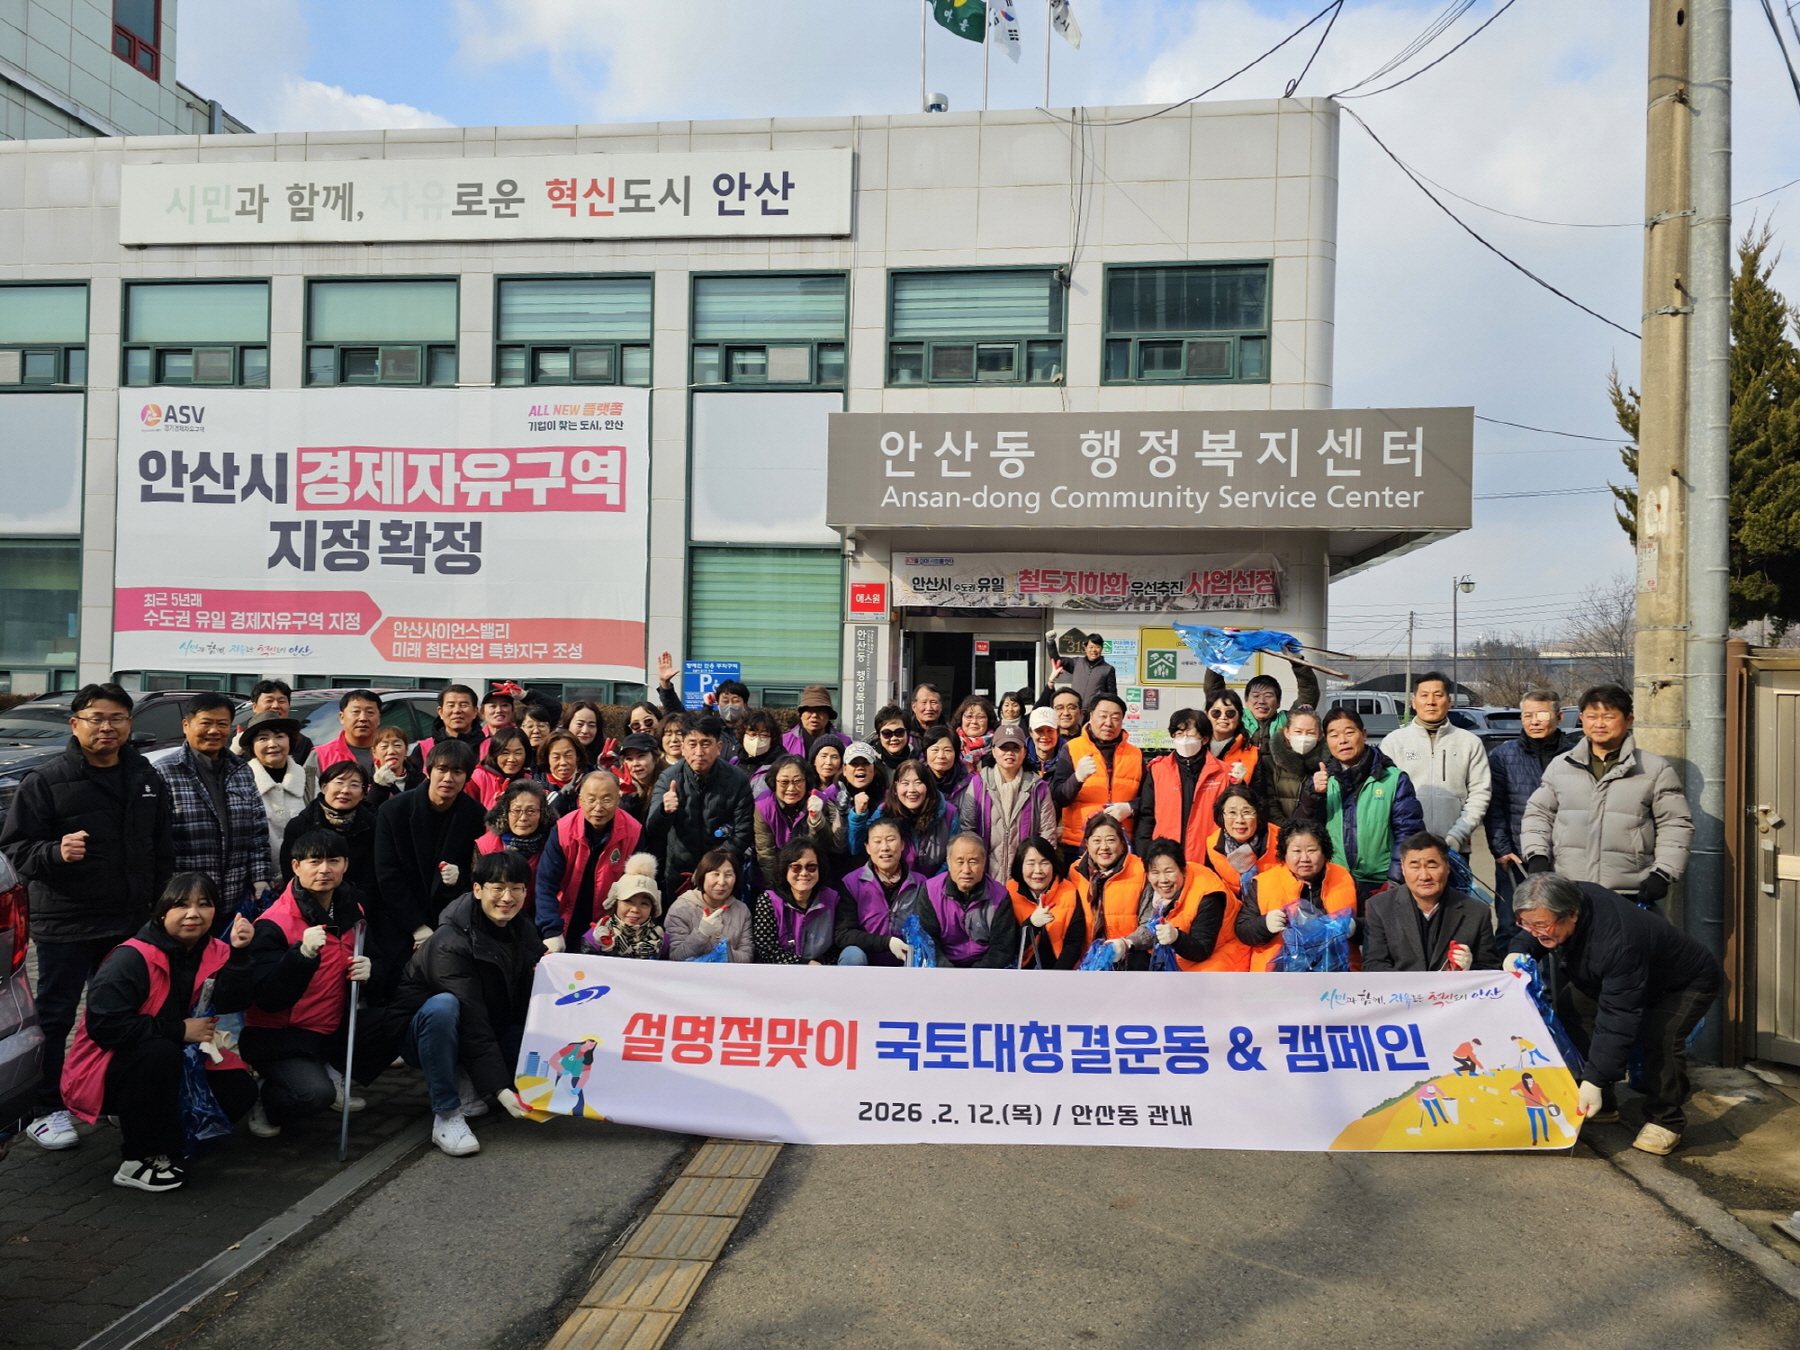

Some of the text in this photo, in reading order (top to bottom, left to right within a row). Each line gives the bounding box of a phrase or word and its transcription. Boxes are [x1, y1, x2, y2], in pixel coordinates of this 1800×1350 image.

[165, 182, 270, 225] 시민과
[284, 181, 364, 223] 함께,
[544, 174, 692, 218] 혁신도시
[711, 170, 796, 217] 안산
[164, 404, 205, 424] ASV
[528, 402, 624, 417] ALL NEW 플랫폼
[528, 420, 624, 431] 기업이 찾는 도시, 안산
[880, 427, 1425, 480] 안산동 행정복지센터
[138, 449, 622, 507] 안산시 경제자유구역
[880, 484, 1424, 514] Ansan-dong Community Service Center
[911, 569, 1277, 596] 안산시 수도권 유일 철도지하화 우선추진 사업선정
[144, 592, 203, 608] 최근 5년래
[855, 593, 880, 604] 에스원
[144, 609, 361, 631] 수도권 유일 경제자유구역 지정
[393, 621, 510, 640] 안산사이언스밸리
[392, 642, 583, 660] 미래 첨단산업 특화지구 조성
[856, 629, 867, 663] 안산동
[700, 673, 712, 692] P
[855, 670, 866, 736] 행정복지센터
[1320, 988, 1356, 1010] 시민과
[1471, 987, 1505, 1000] 안산
[621, 1011, 1430, 1076] 설명절맞이 국토대청결운동 & 캠페인
[858, 1101, 923, 1124] 2026
[1053, 1104, 1062, 1127] /
[1071, 1104, 1138, 1127] 안산동
[1147, 1104, 1193, 1127] 관내
